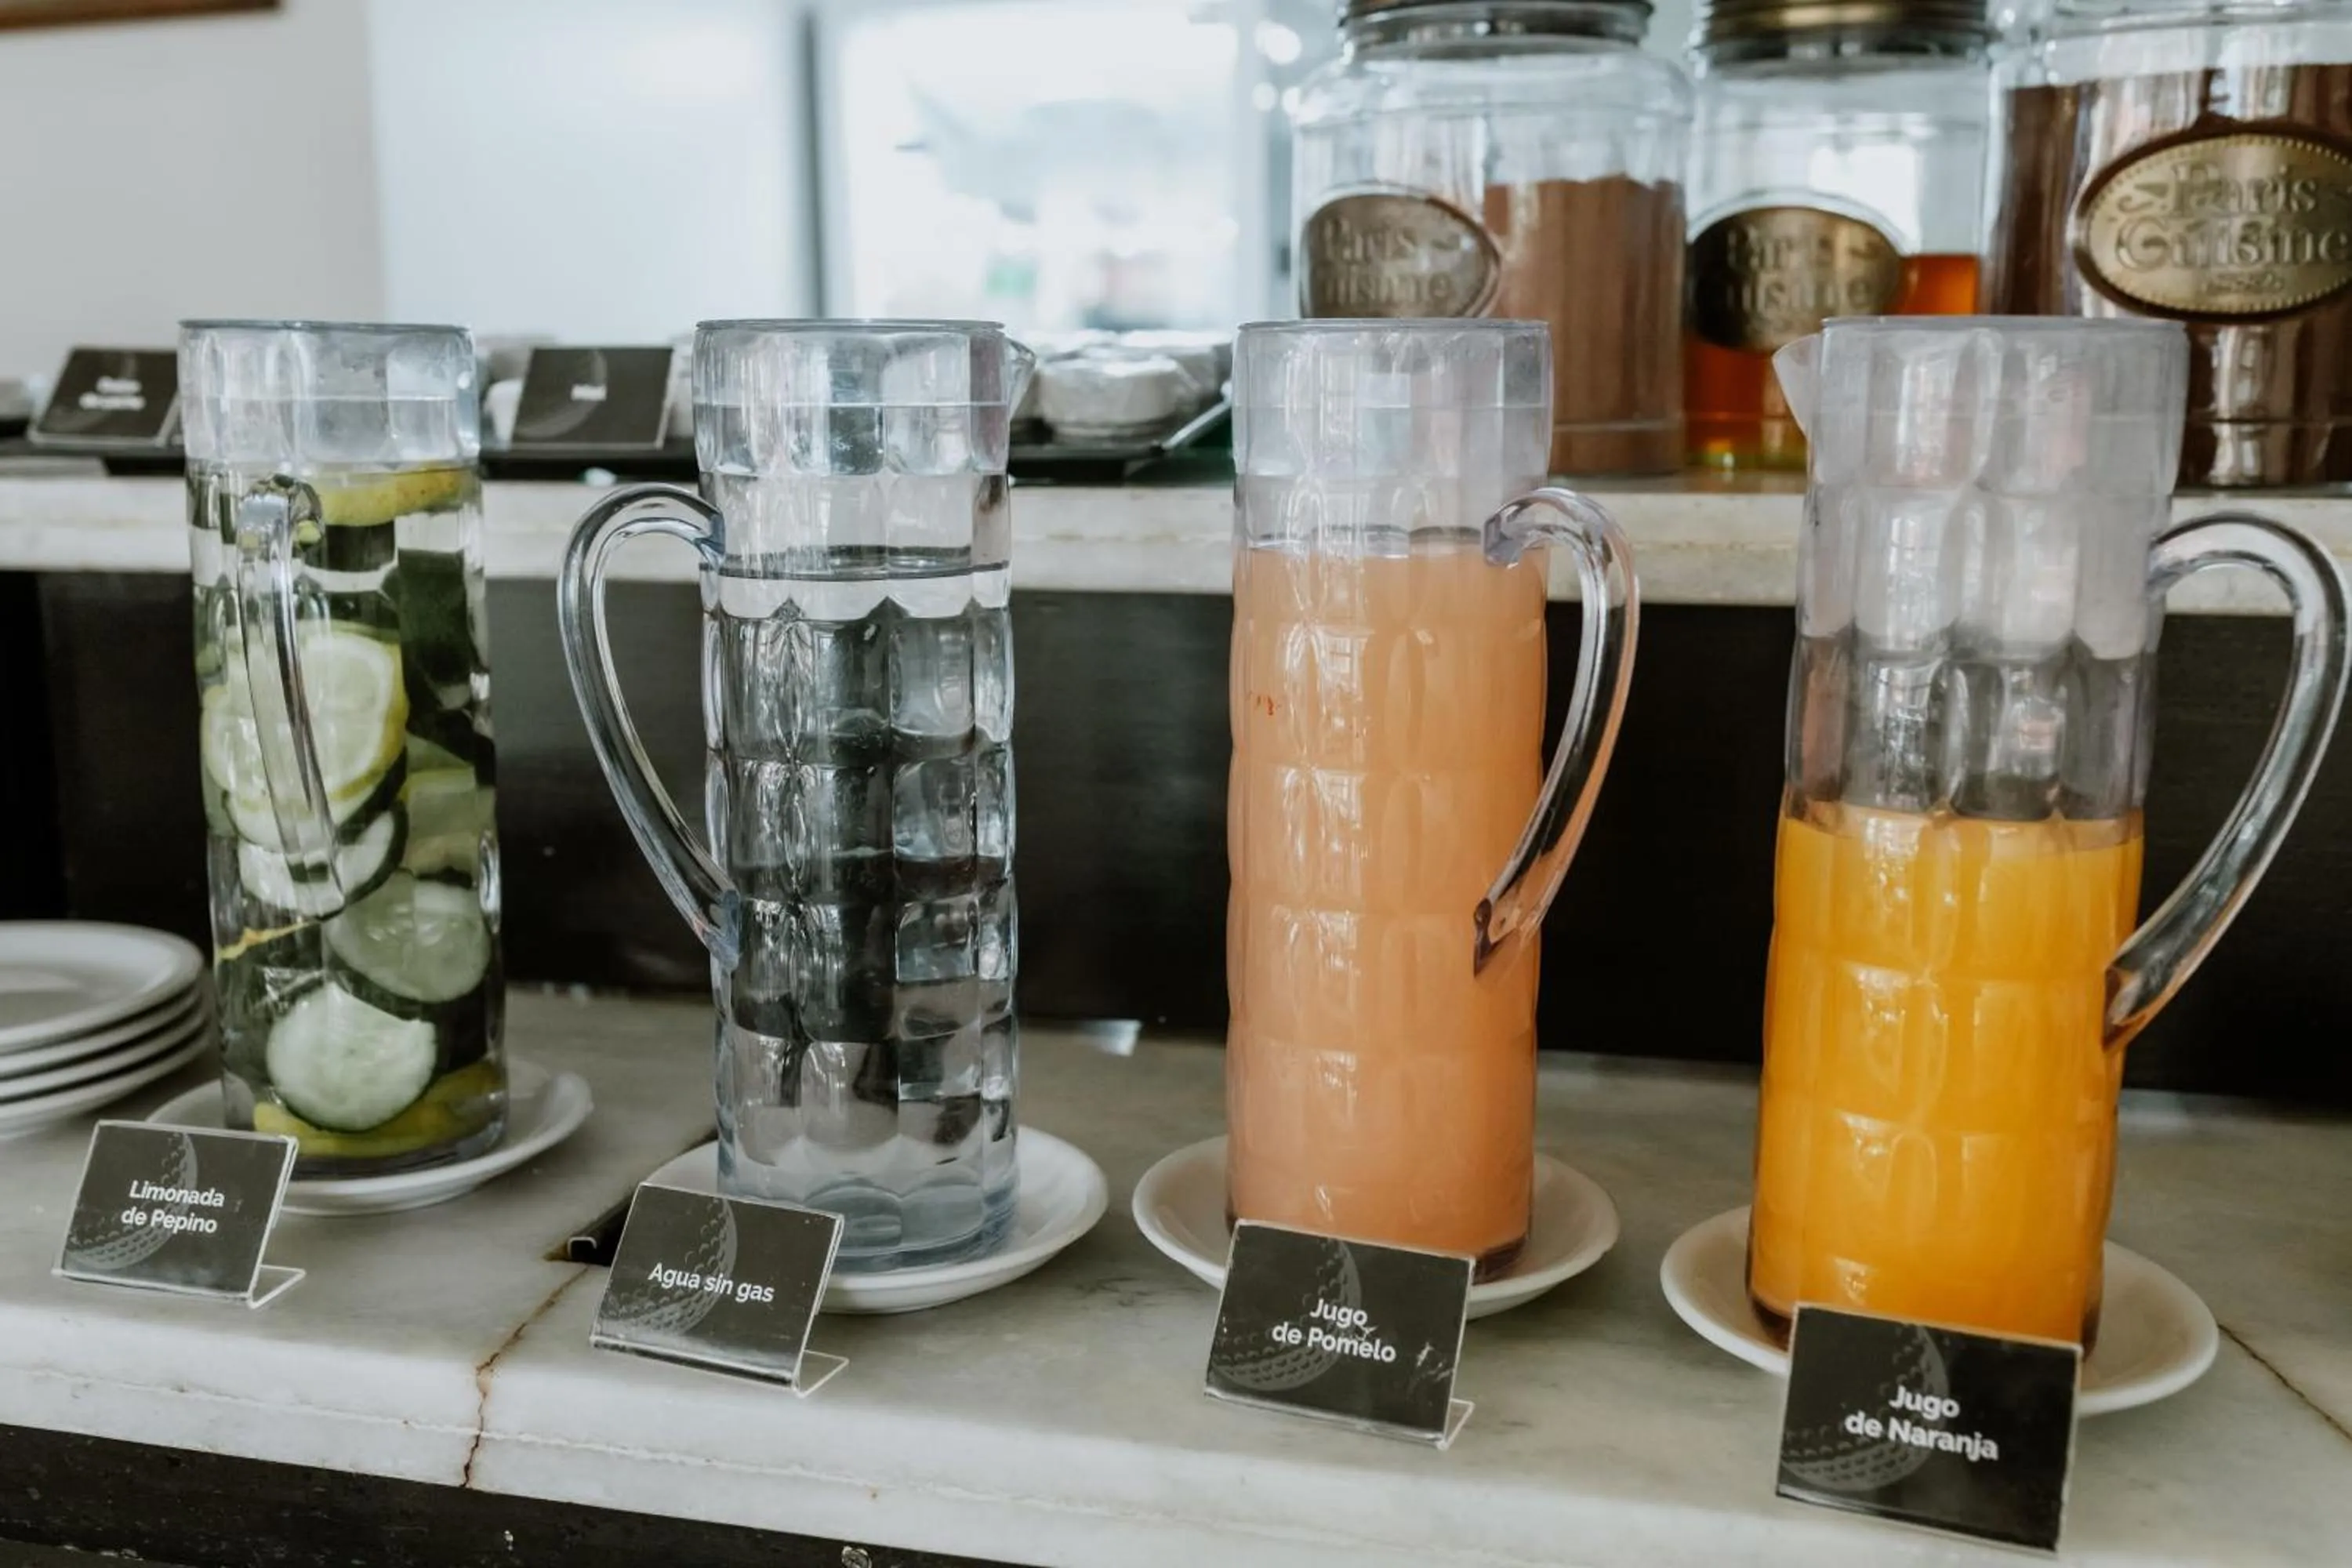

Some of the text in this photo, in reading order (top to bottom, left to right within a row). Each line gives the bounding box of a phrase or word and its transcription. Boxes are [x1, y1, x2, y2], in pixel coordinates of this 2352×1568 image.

[129, 1180, 225, 1207] Limonada
[121, 1206, 218, 1235] de Pepino
[648, 1261, 775, 1303] Agua sin gas
[1309, 1298, 1368, 1328] Jugo
[1272, 1321, 1397, 1363] de Pomelo
[1889, 1385, 1960, 1421] Jugo
[1845, 1410, 2000, 1462] de Naranja
